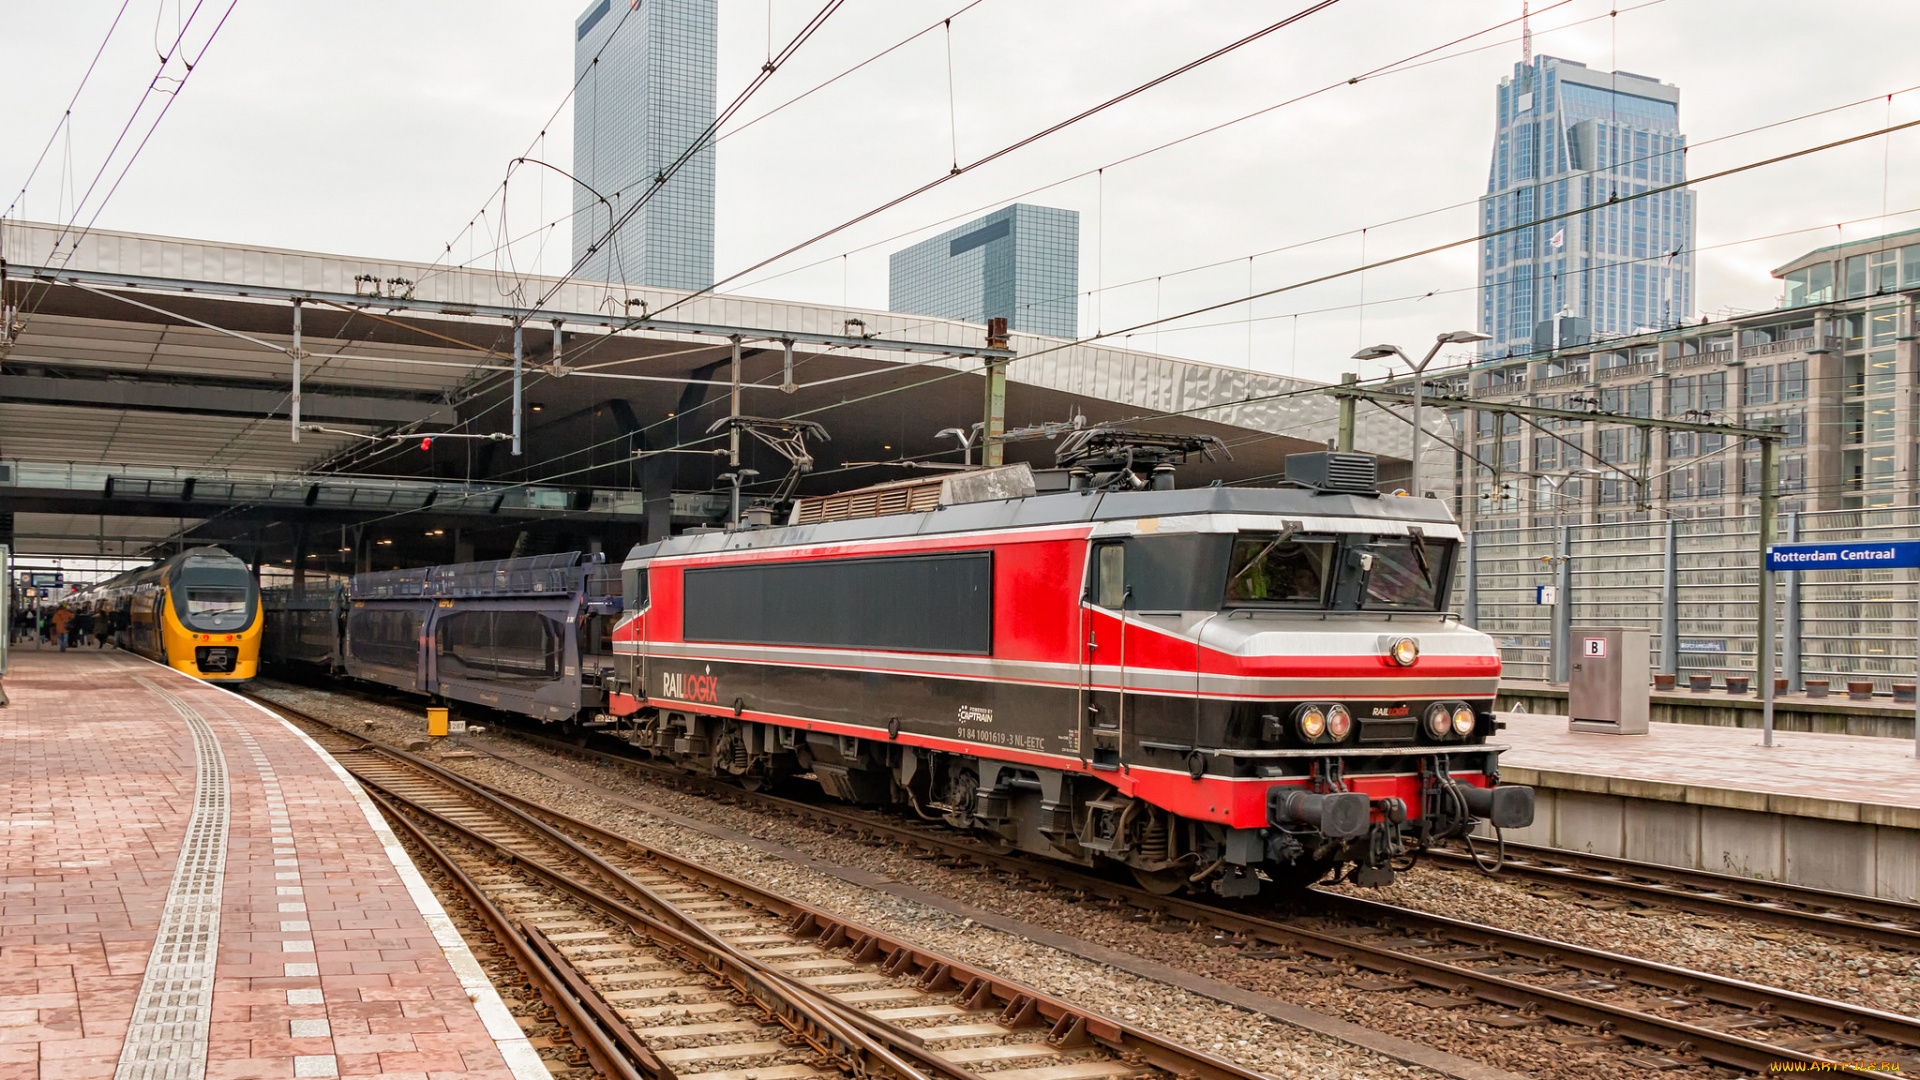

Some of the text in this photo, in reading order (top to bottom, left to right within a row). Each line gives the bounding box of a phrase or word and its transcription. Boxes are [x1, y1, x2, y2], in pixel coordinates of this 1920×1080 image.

[1773, 547, 1895, 563] Rotterdam Centraal
[1591, 641, 1599, 654] B
[663, 671, 718, 703] RAILLOGIX
[960, 710, 993, 723] CAPTRAIN
[957, 727, 966, 738] 91
[966, 728, 976, 740] 84
[1014, 734, 1045, 750] NL-EETC
